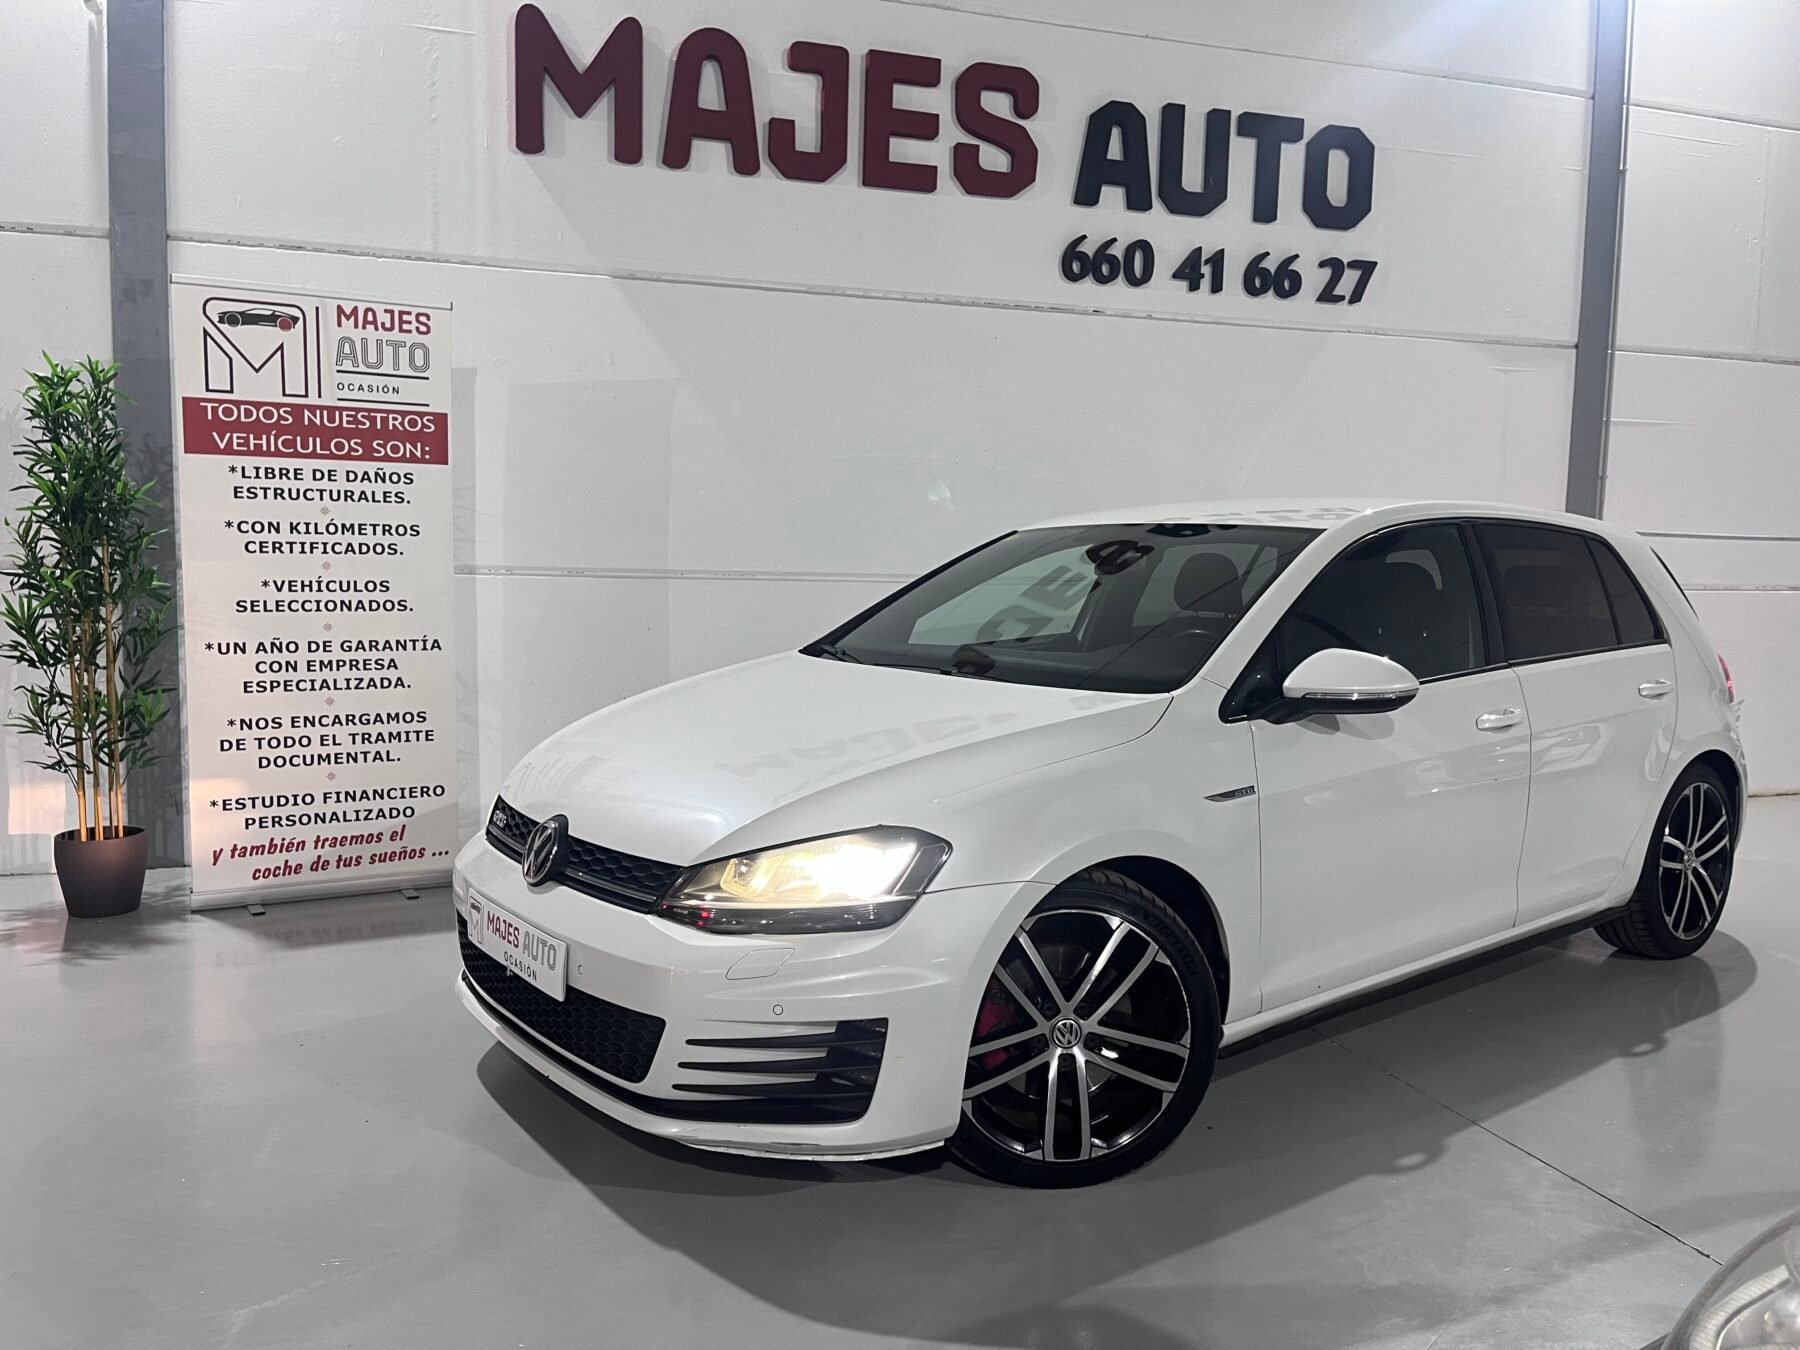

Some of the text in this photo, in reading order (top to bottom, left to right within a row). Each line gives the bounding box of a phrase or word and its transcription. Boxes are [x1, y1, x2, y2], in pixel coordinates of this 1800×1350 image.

[515, 3, 1376, 231] MAJES AUTO
[1061, 234, 1379, 305] 660 41 66 27
[336, 304, 431, 335] MAJES
[336, 336, 430, 372] AUTO
[337, 382, 400, 394] OCASIÓN
[200, 402, 435, 432] TODOS NUESTROS
[212, 430, 430, 459] VEHÍCULOS SON:
[312, 468, 338, 482] DE
[345, 465, 414, 485] DAÑOS
[233, 486, 411, 504] ESTRUCTURALES.
[289, 519, 420, 536] KILÓMETROS
[244, 541, 404, 556] CERTIFICADOS.
[235, 599, 414, 613] SELECCIONADOS.
[255, 638, 300, 654] AÑO
[307, 641, 333, 653] DE
[340, 636, 442, 652] GARANTÍA
[255, 658, 398, 674] CON EMPRESA
[243, 676, 411, 694] ESPECIALIZADA.
[290, 711, 428, 729] ENCARGAMOS
[220, 730, 435, 752] DE TODO EL TRAMITE
[258, 750, 401, 769] DOCUMENTAL.
[322, 785, 446, 804] FINANCIERO
[244, 806, 416, 830] PERSONALIZADO
[212, 824, 406, 866] y también traemos el
[252, 857, 302, 880] coche
[310, 856, 330, 873] de
[335, 854, 362, 869] tus
[368, 846, 426, 865] sueños
[487, 911, 557, 971] MAJES AUTO
[504, 951, 537, 982] OCASIÓN
